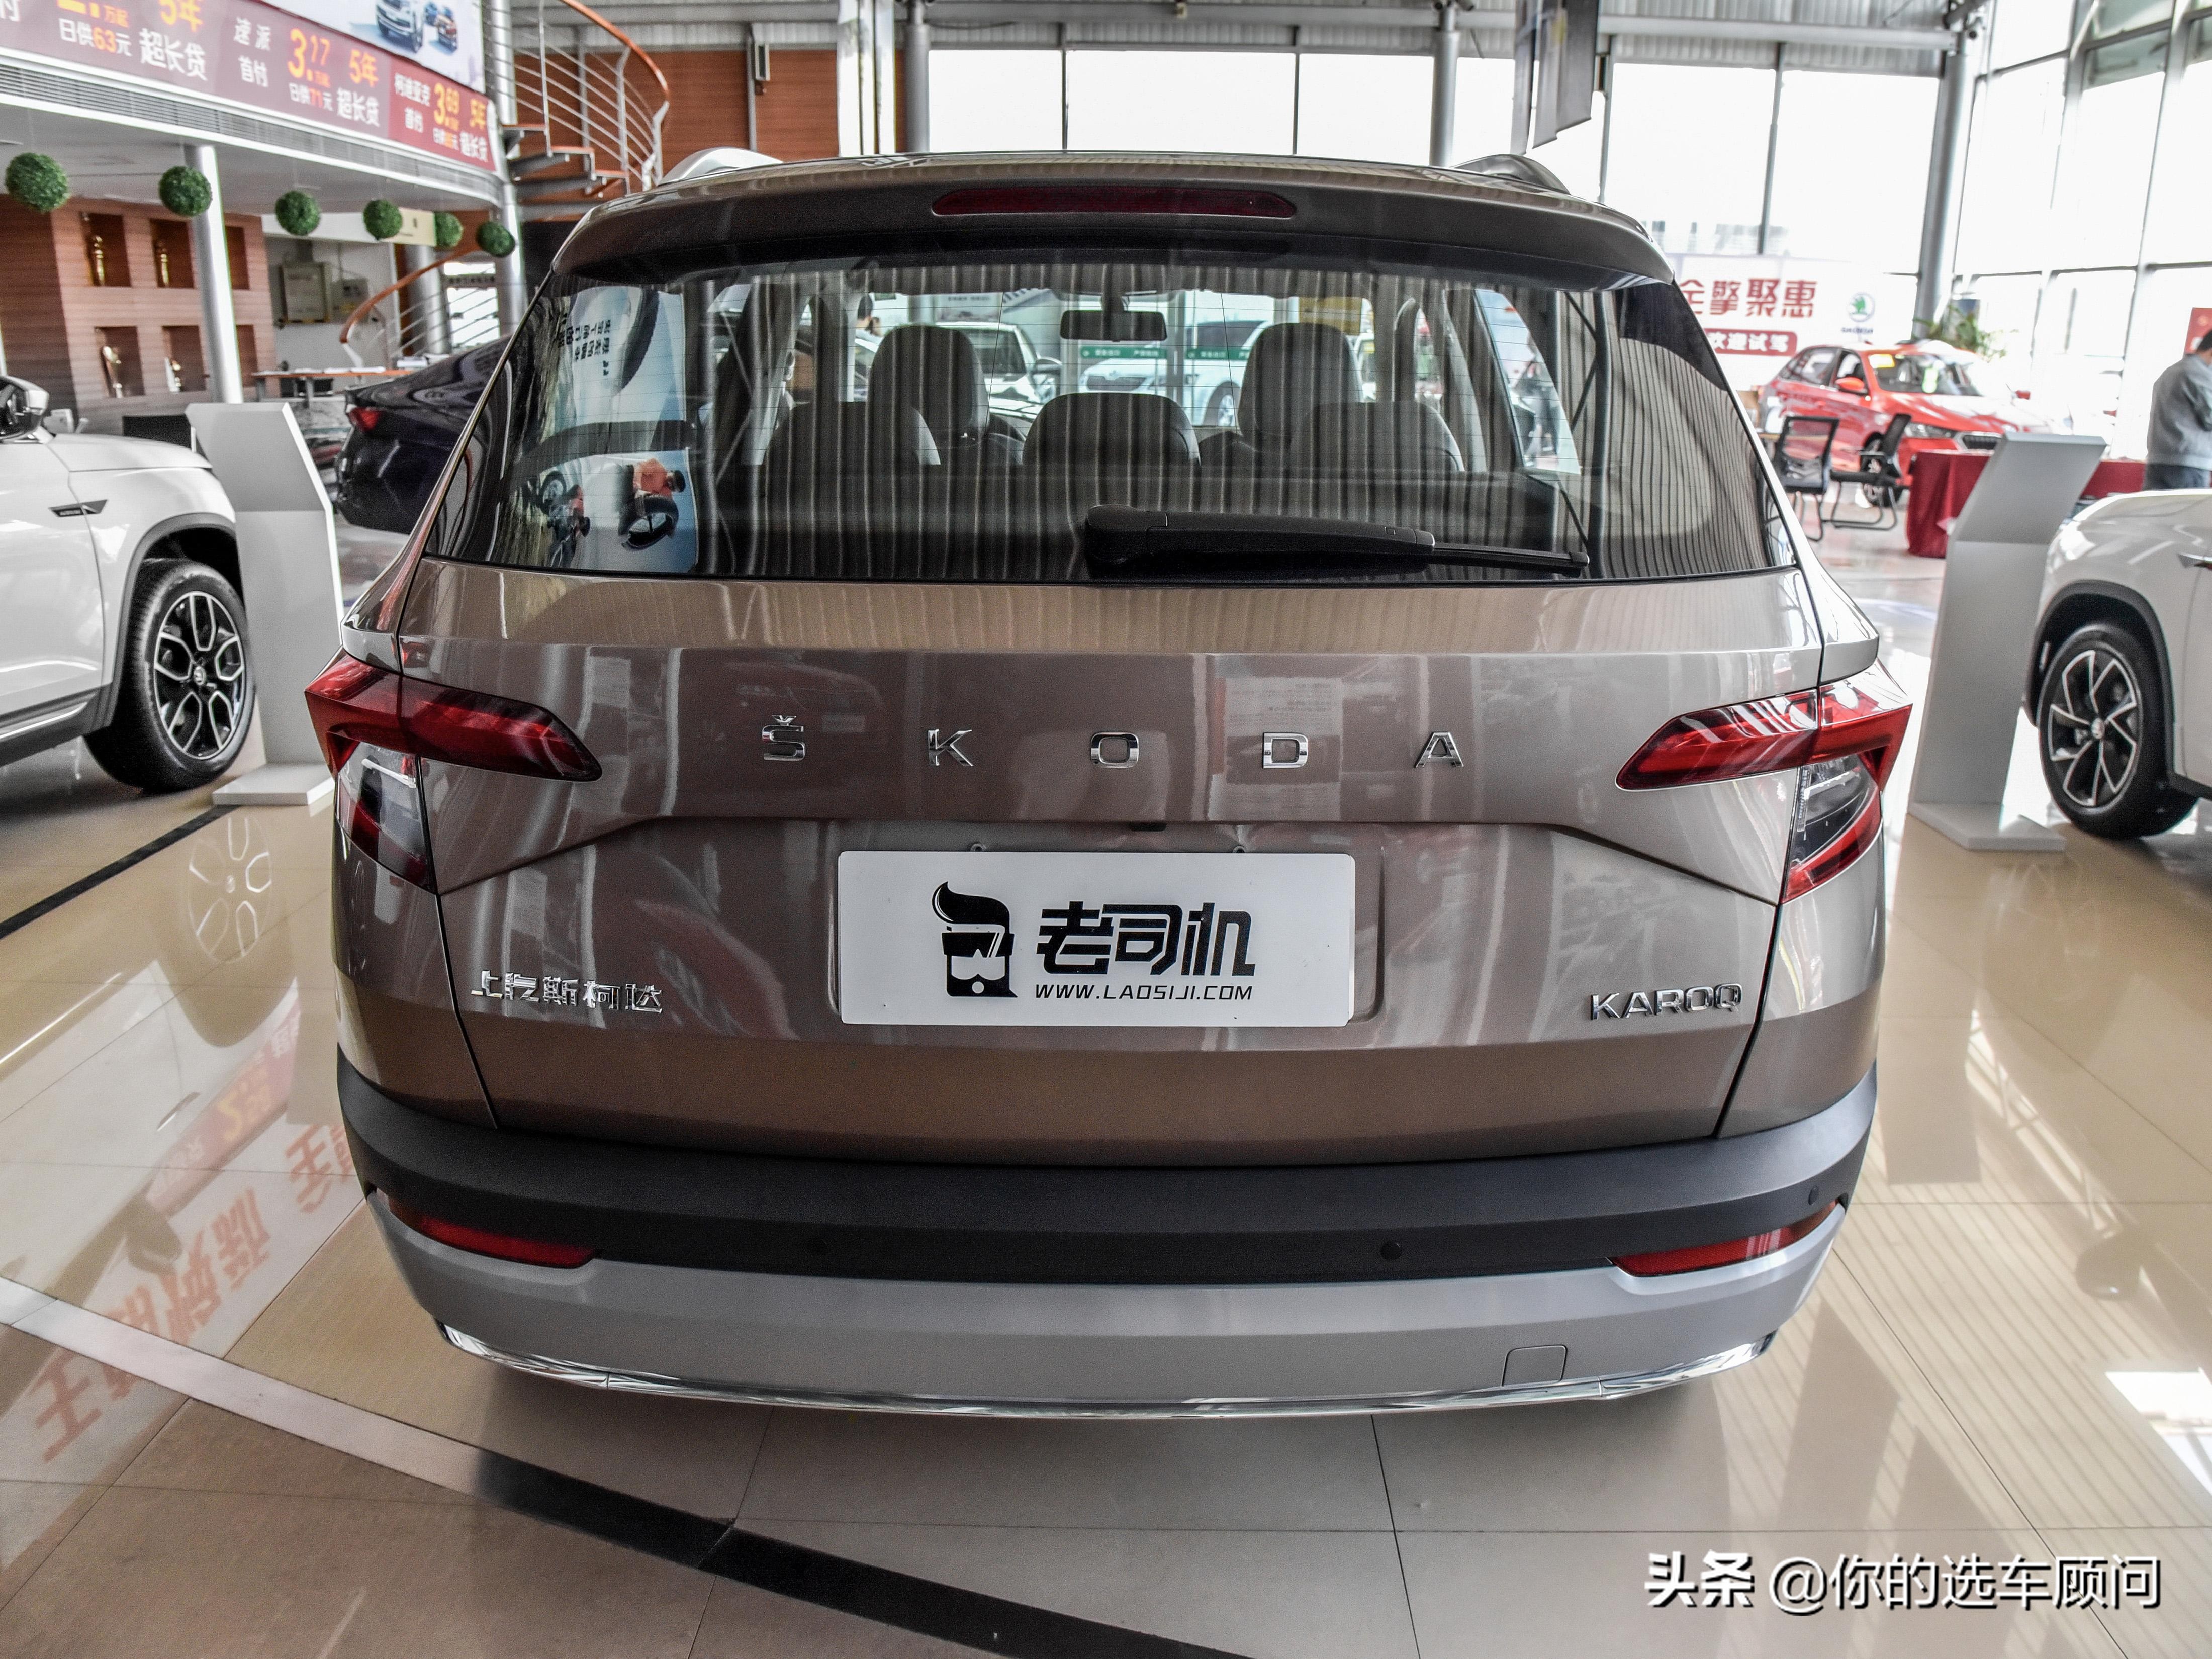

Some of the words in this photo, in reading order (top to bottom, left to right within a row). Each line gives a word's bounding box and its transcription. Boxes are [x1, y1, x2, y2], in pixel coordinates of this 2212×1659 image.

[58, 18, 133, 57] 日供63元
[139, 28, 208, 81] 超长贷
[348, 49, 379, 87] 5年
[238, 55, 268, 88] 首付
[336, 87, 380, 127] 超长贷
[1036, 901, 1256, 977] 老司机
[471, 969, 663, 1014] 上汽斯柯达
[1035, 983, 1253, 1001] WWW.LAOSIJI.COM
[1590, 982, 1743, 1021] KAROQ
